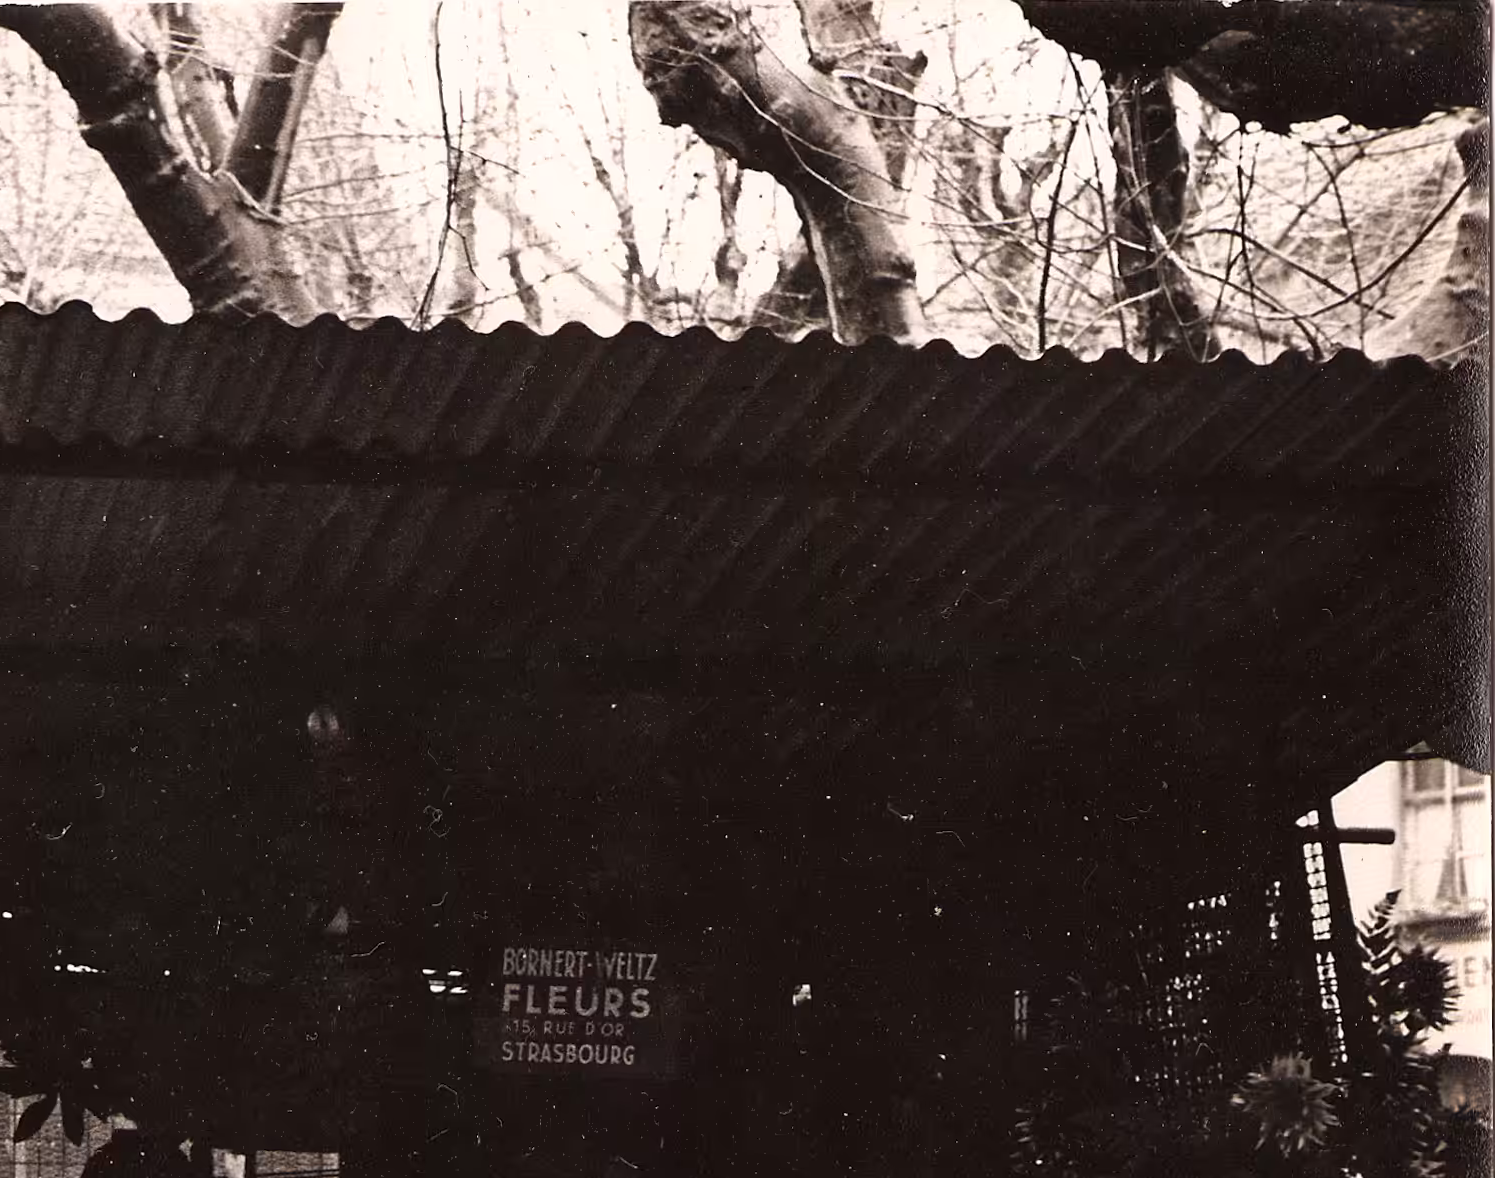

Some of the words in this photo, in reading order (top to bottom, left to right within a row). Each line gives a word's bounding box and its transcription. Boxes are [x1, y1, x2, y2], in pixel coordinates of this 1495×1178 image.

[502, 983, 652, 1019] FLEURS
[543, 1020, 575, 1035] RUE
[502, 1041, 636, 1065] STRASBOURG
